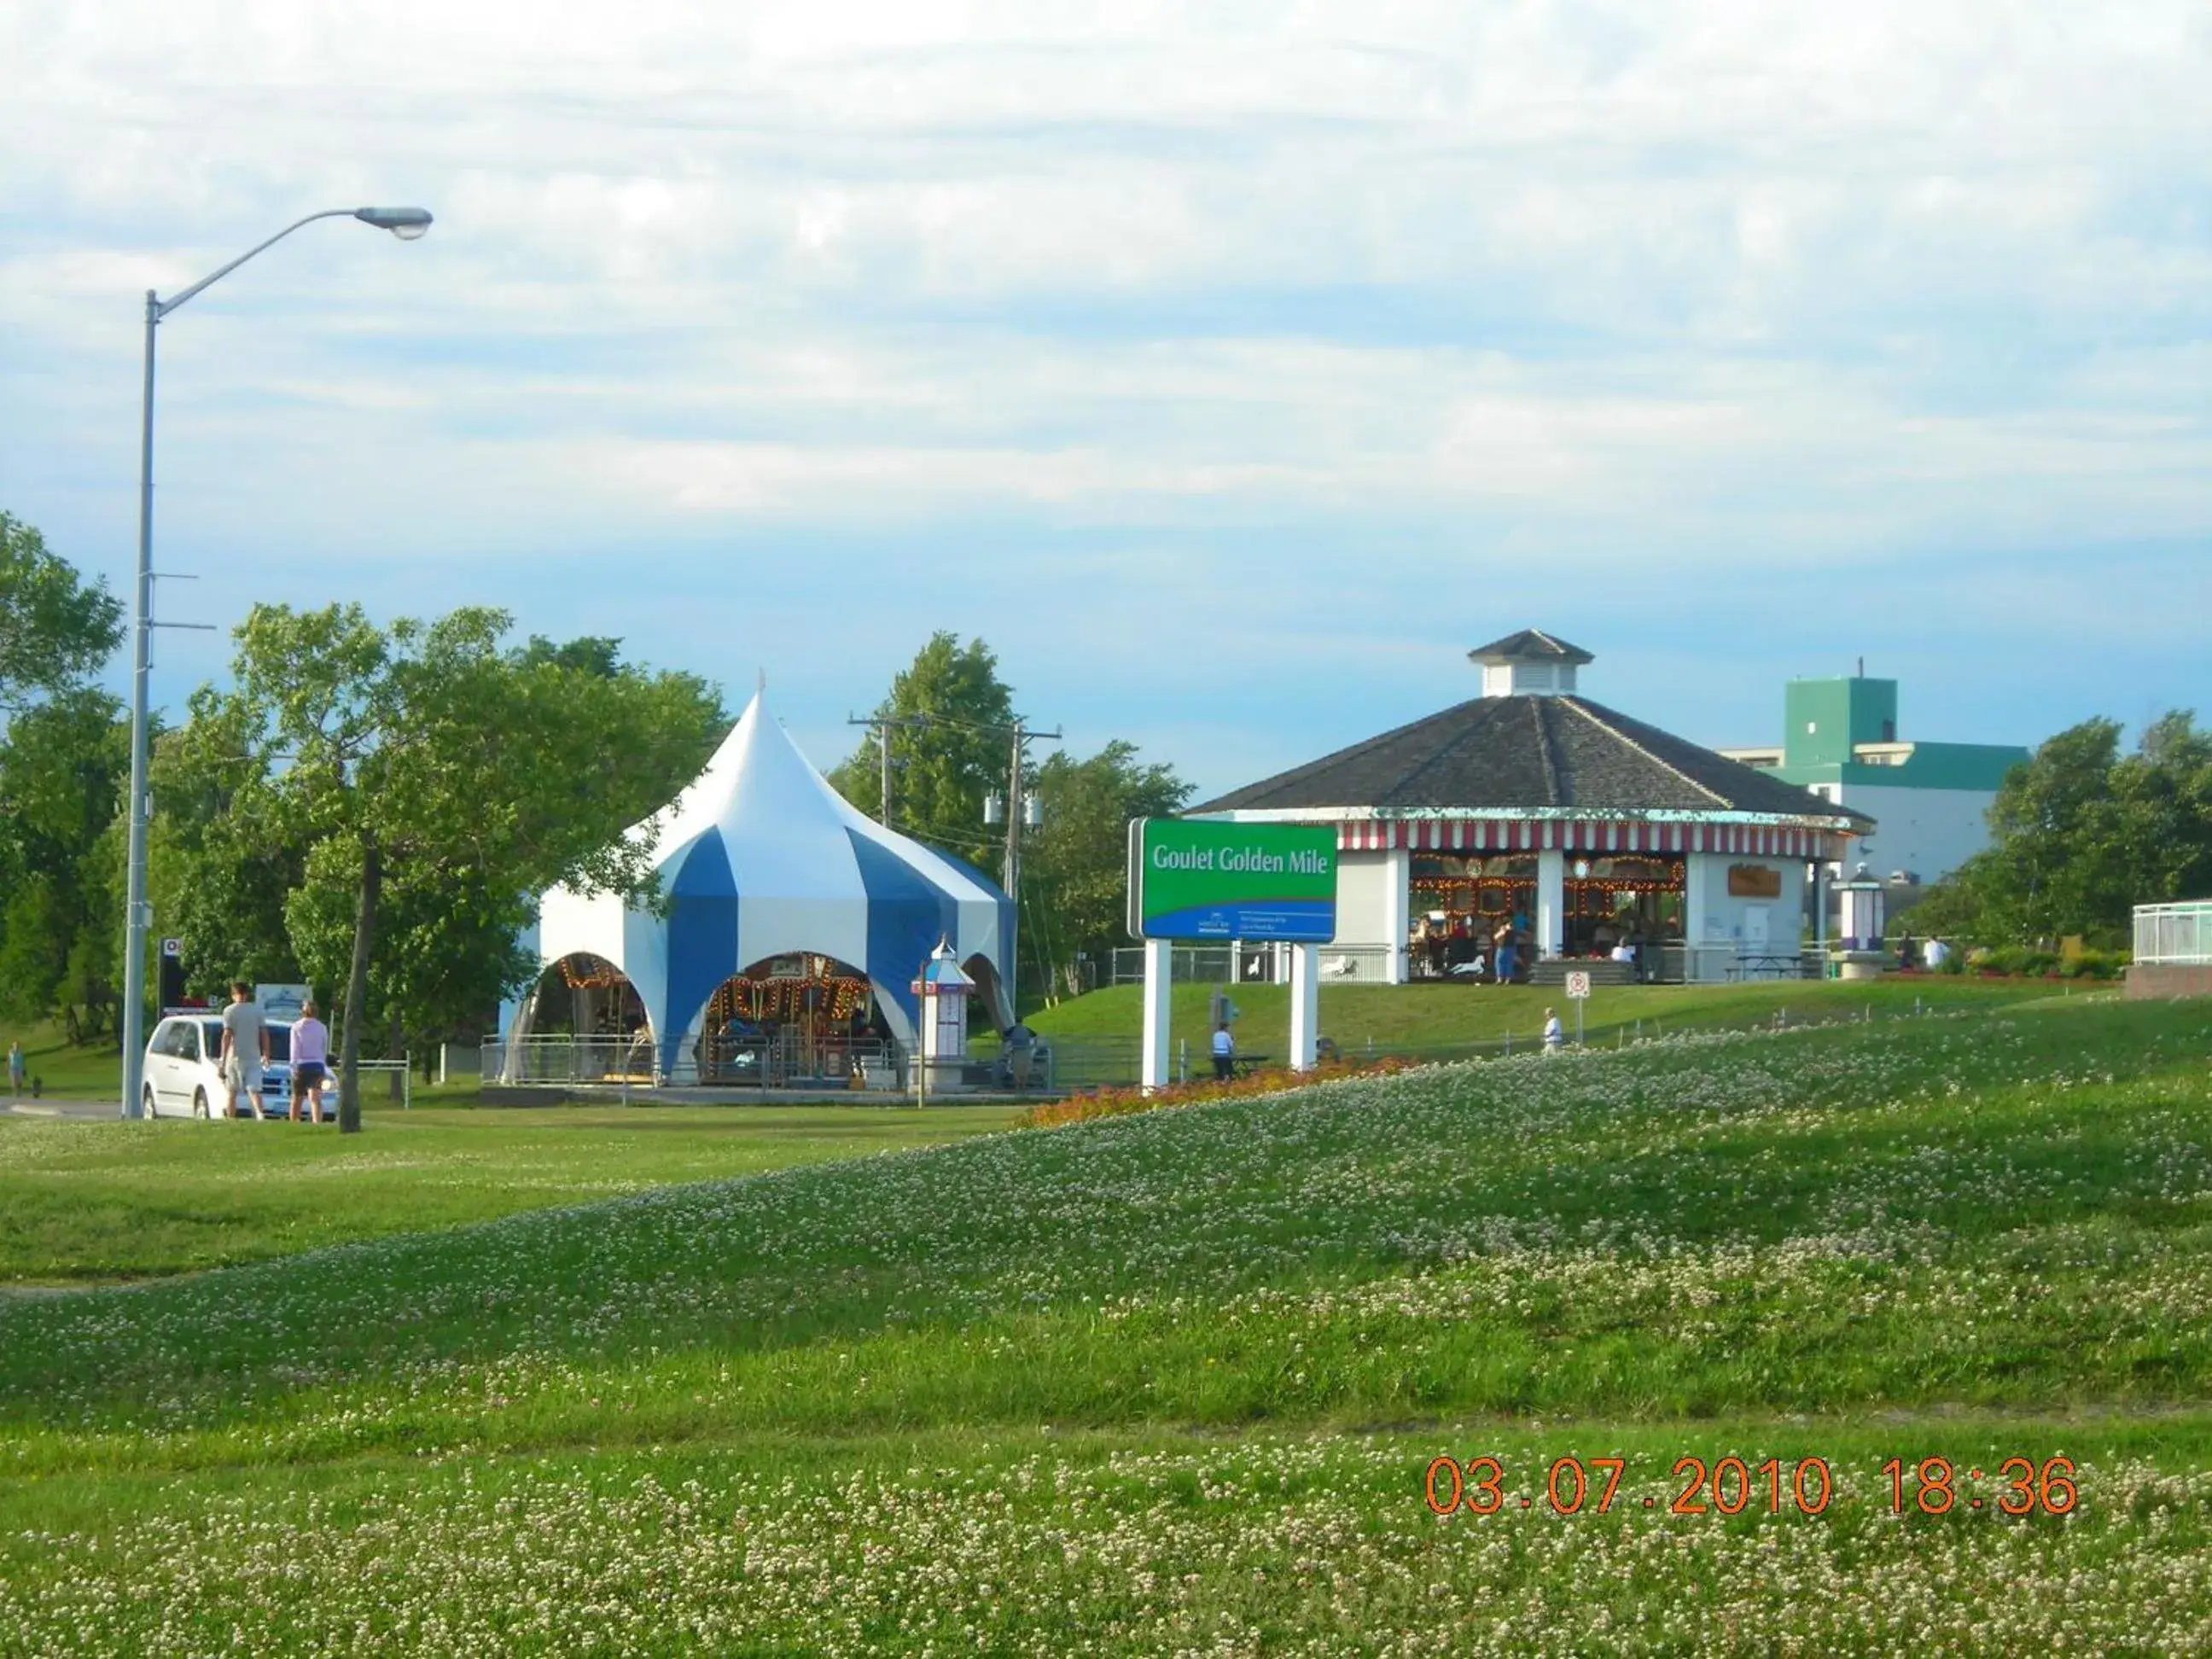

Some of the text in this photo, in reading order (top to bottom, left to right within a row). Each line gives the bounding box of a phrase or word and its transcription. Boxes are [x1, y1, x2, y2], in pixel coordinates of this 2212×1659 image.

[1153, 844, 1329, 875] Goulet Golden Mile
